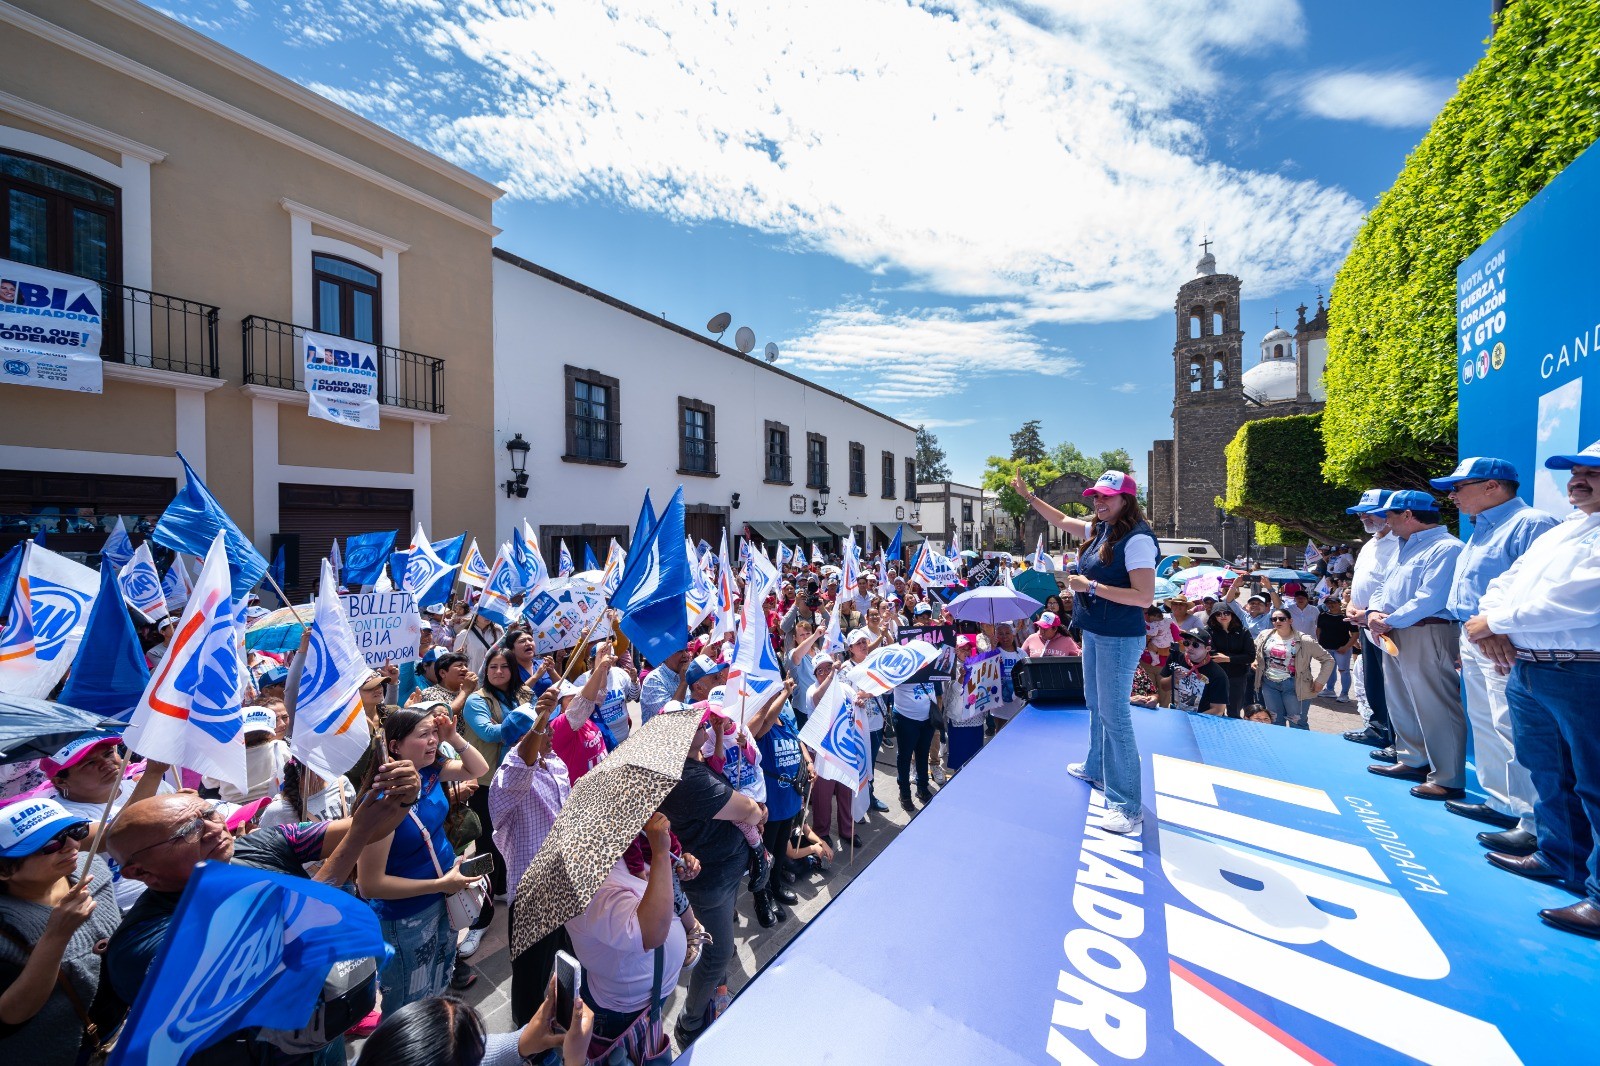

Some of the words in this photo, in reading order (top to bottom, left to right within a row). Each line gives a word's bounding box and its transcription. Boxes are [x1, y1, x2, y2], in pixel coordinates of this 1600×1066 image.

[1461, 269, 1483, 295] VOTA
[1485, 249, 1505, 276] CON
[1461, 278, 1496, 313] FUERZA
[1497, 268, 1505, 284] Y
[1461, 289, 1506, 331] CORAZÓN
[49, 329, 80, 338] QUE
[1461, 331, 1472, 355] X
[1475, 310, 1506, 346] GTO
[307, 345, 376, 372] LIBIA
[307, 363, 377, 378] GOBERNADORA
[362, 645, 414, 665] RNADORA
[10, 803, 49, 825] LIBIA
[1344, 795, 1448, 896] CANDIDATA
[209, 912, 284, 1009] PAN
